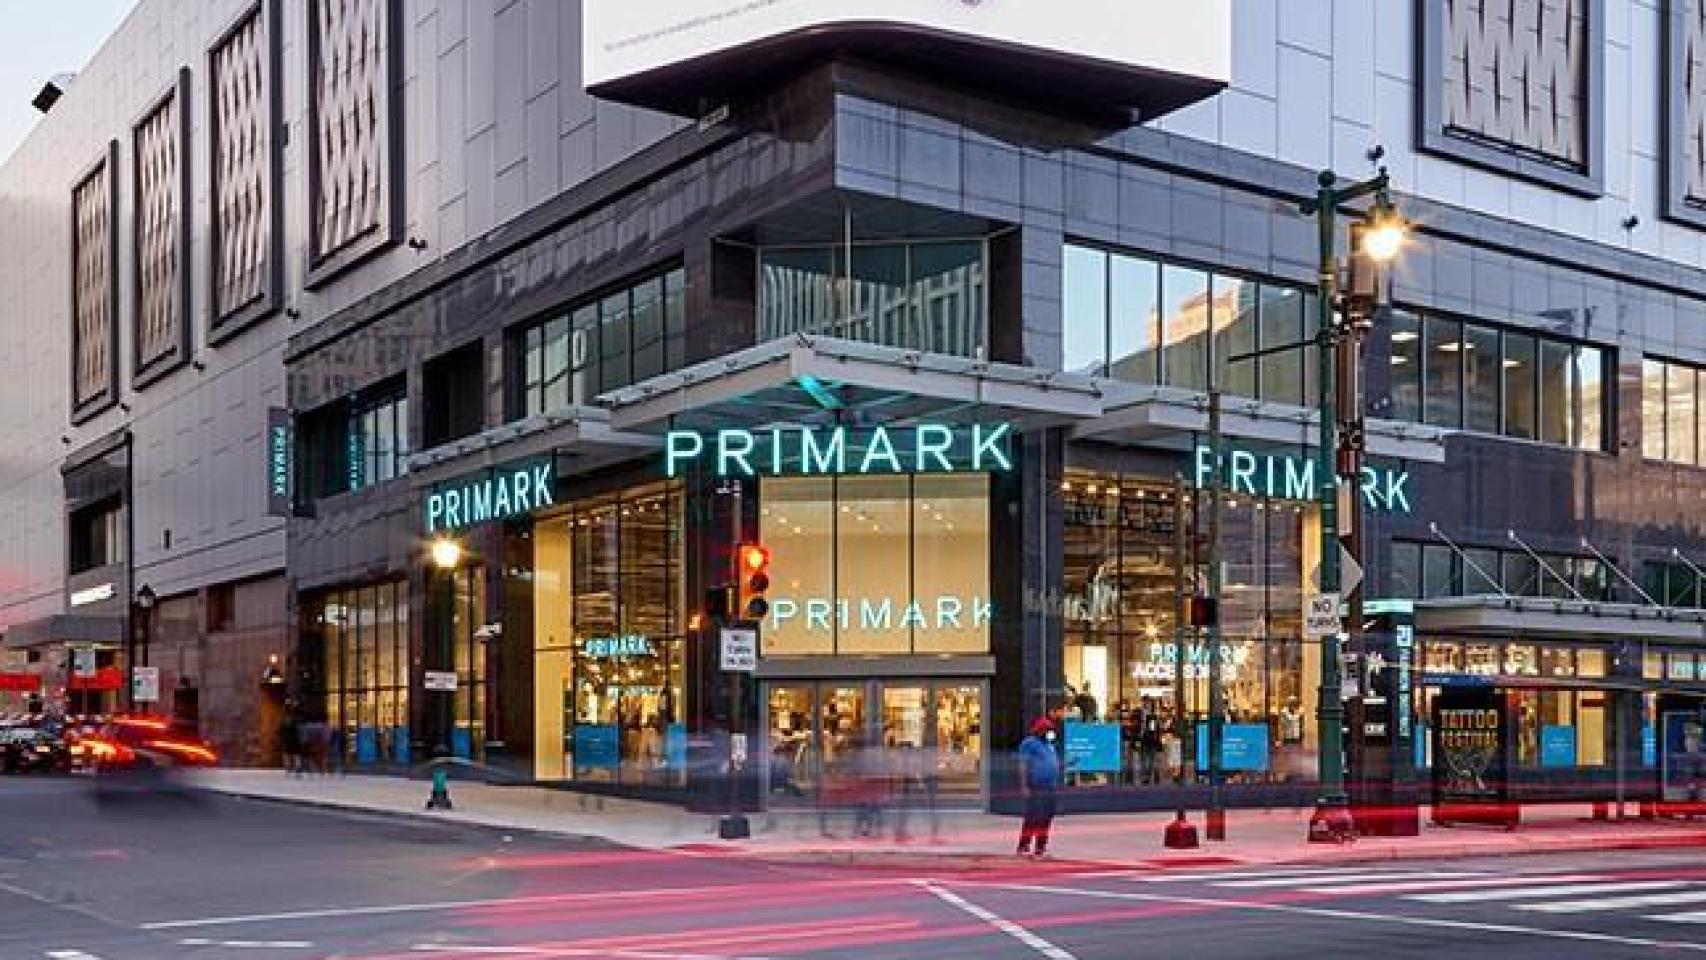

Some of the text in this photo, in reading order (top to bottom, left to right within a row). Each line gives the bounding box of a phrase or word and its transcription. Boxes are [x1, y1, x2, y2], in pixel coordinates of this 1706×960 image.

[272, 427, 286, 495] PRIMARK
[666, 423, 1013, 477] PRIMARK
[428, 463, 553, 533] PRIMARK
[1195, 446, 1409, 512] PRIMRK
[772, 596, 991, 631] PRIMARK
[1312, 599, 1331, 613] NO
[1439, 708, 1498, 729] TATTOO
